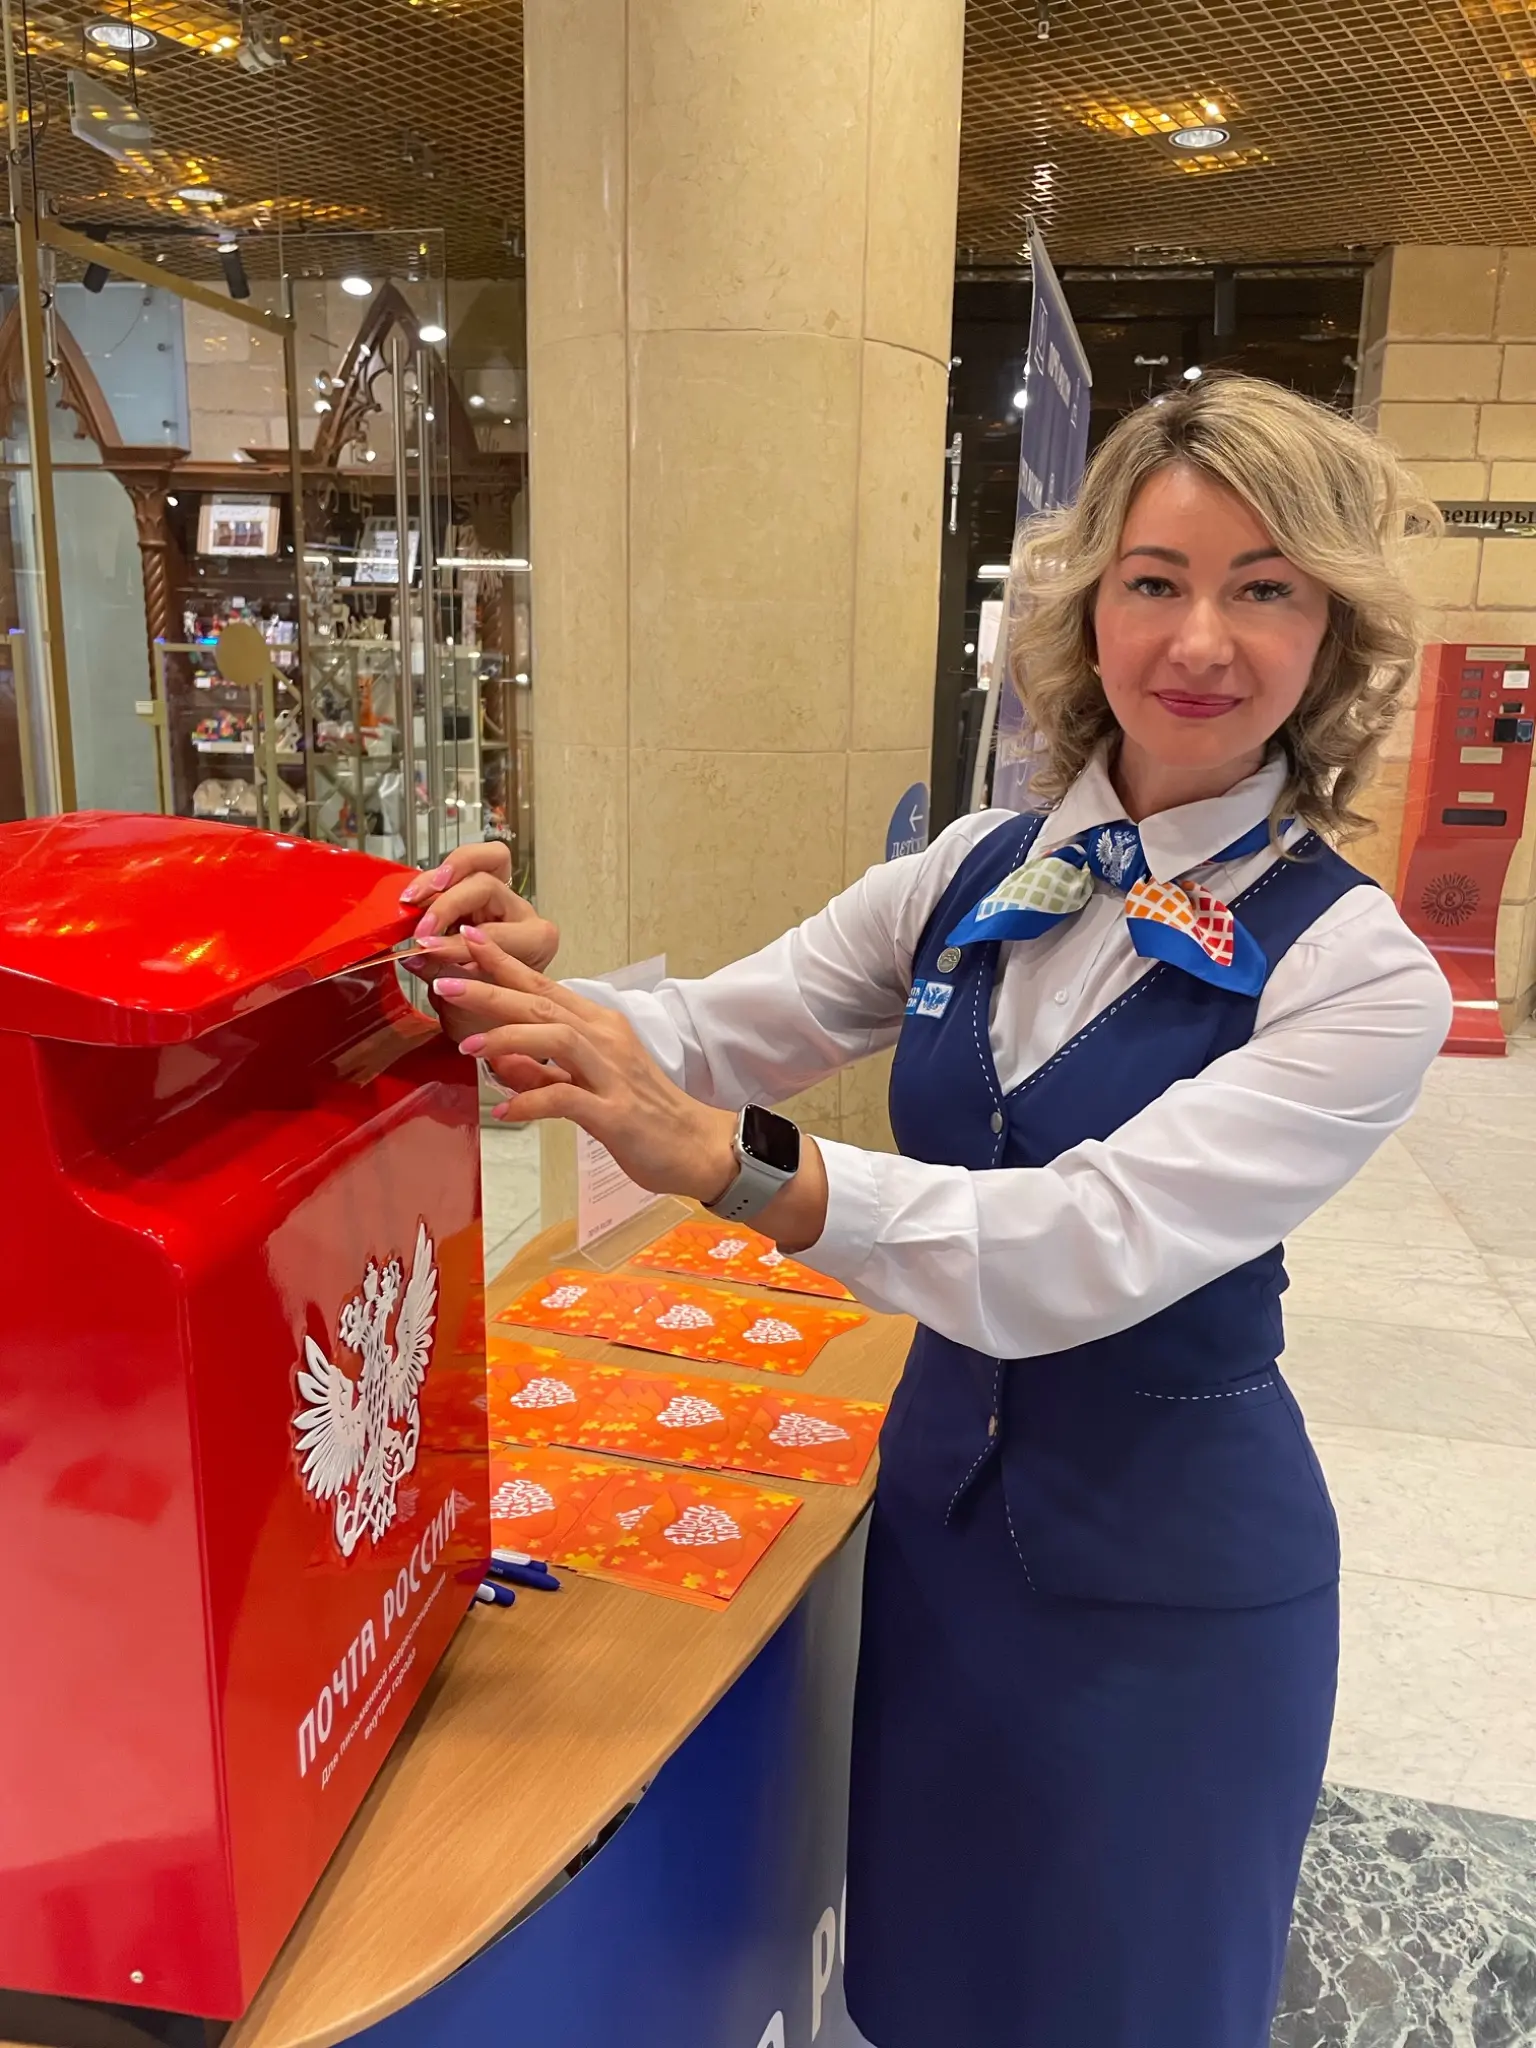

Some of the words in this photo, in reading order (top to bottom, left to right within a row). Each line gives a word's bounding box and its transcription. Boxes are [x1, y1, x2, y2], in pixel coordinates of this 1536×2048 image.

[1438, 508, 1536, 530] вениры
[298, 1618, 376, 1778] ПОЧТА
[383, 1488, 456, 1640] РОССИИ
[321, 1752, 340, 1791] Для
[340, 1669, 387, 1755] письменной
[364, 1689, 391, 1740] внутри
[391, 1647, 417, 1693] города
